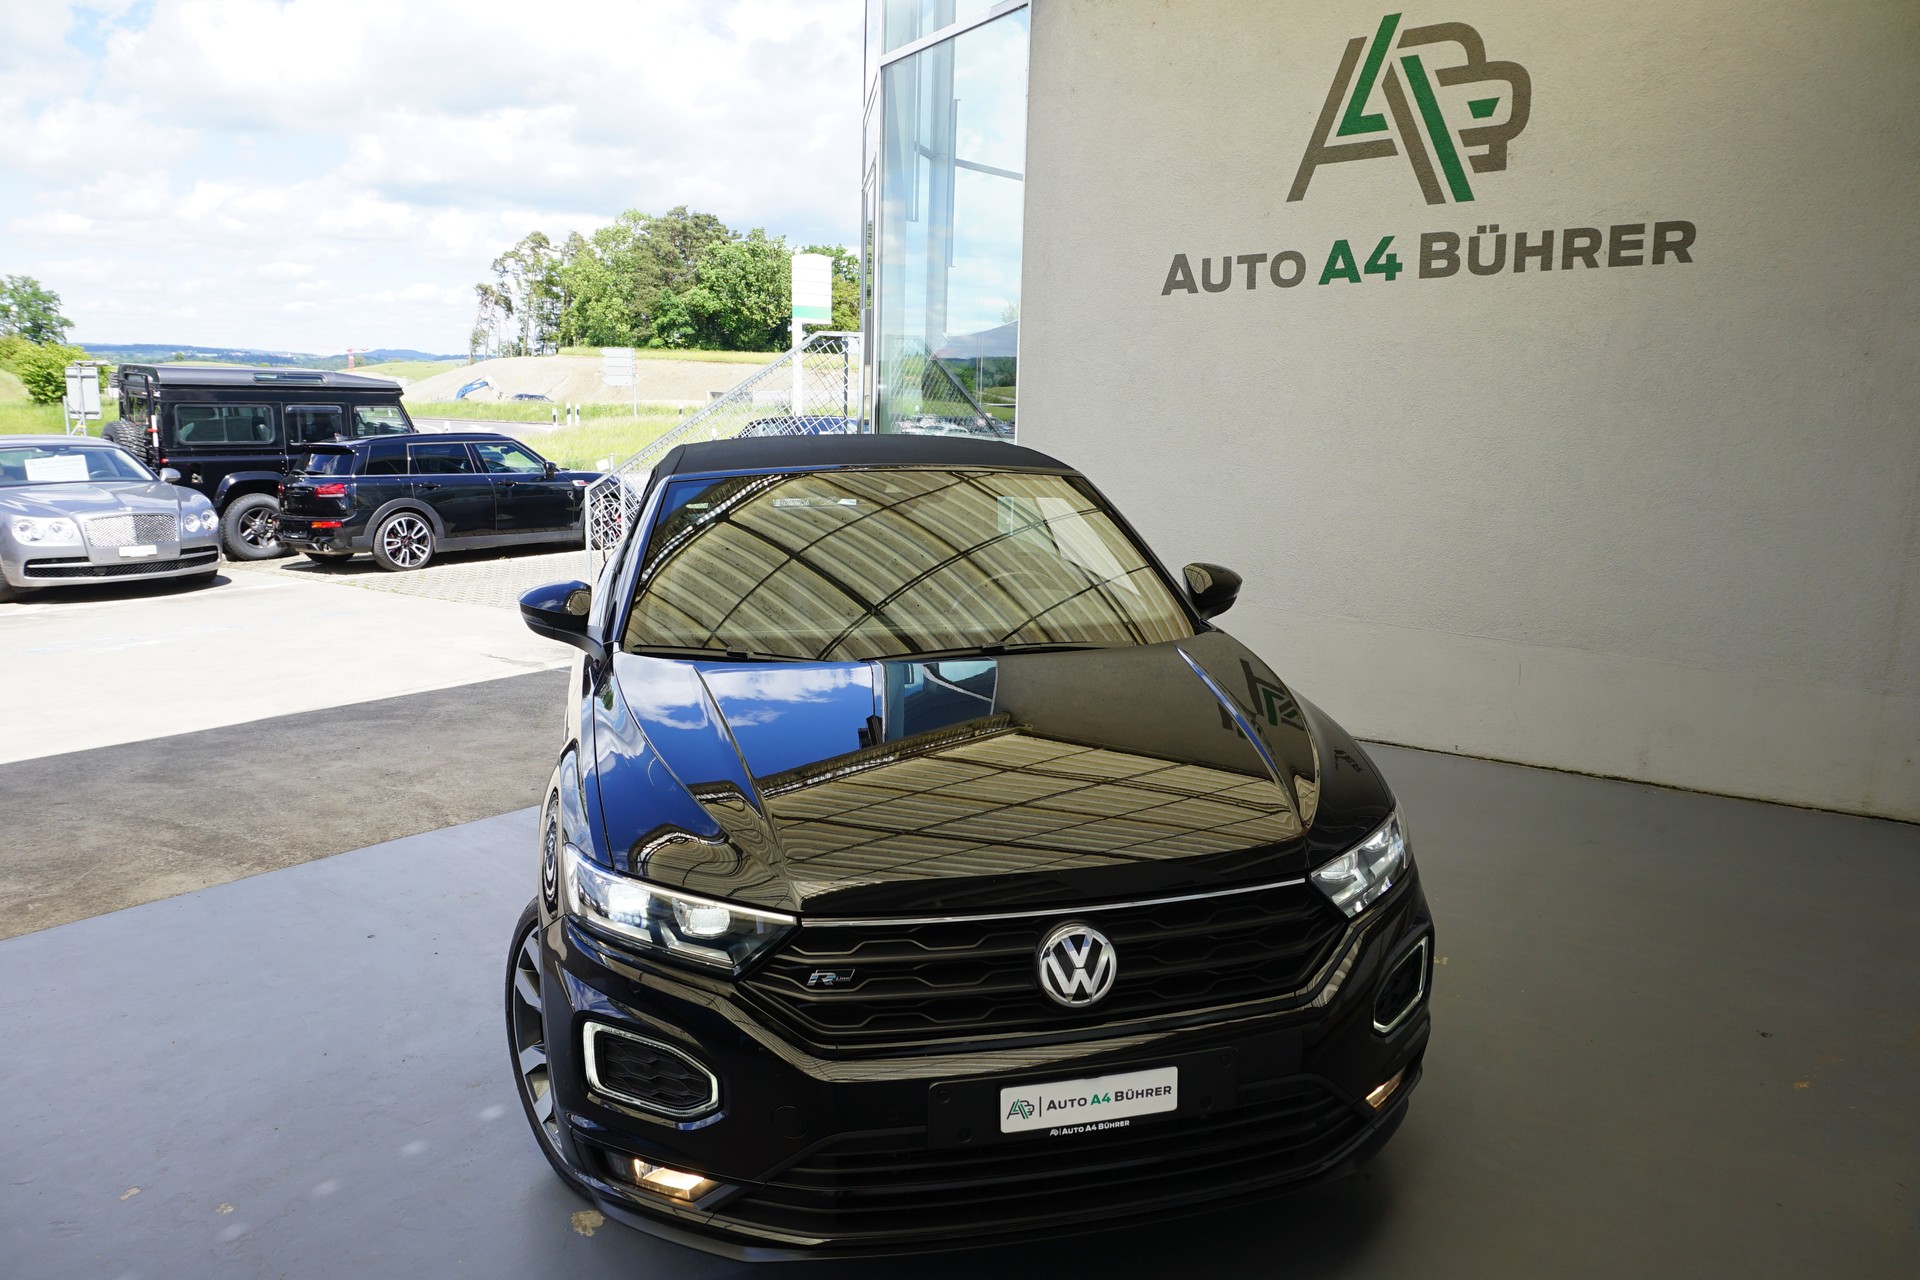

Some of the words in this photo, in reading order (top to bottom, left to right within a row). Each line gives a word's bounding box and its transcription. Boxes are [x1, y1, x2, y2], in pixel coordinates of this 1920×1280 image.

[1160, 250, 1307, 296] AUTO
[1317, 236, 1403, 285] A4
[1417, 220, 1698, 279] BÜHRER
[1046, 1097, 1088, 1112] AUTO
[1090, 1092, 1112, 1106] A4
[1114, 1085, 1172, 1102] BÜHRER
[1061, 1126, 1084, 1135] AUTO
[1085, 1124, 1097, 1132] A4
[1098, 1120, 1130, 1130] BÜHRER
